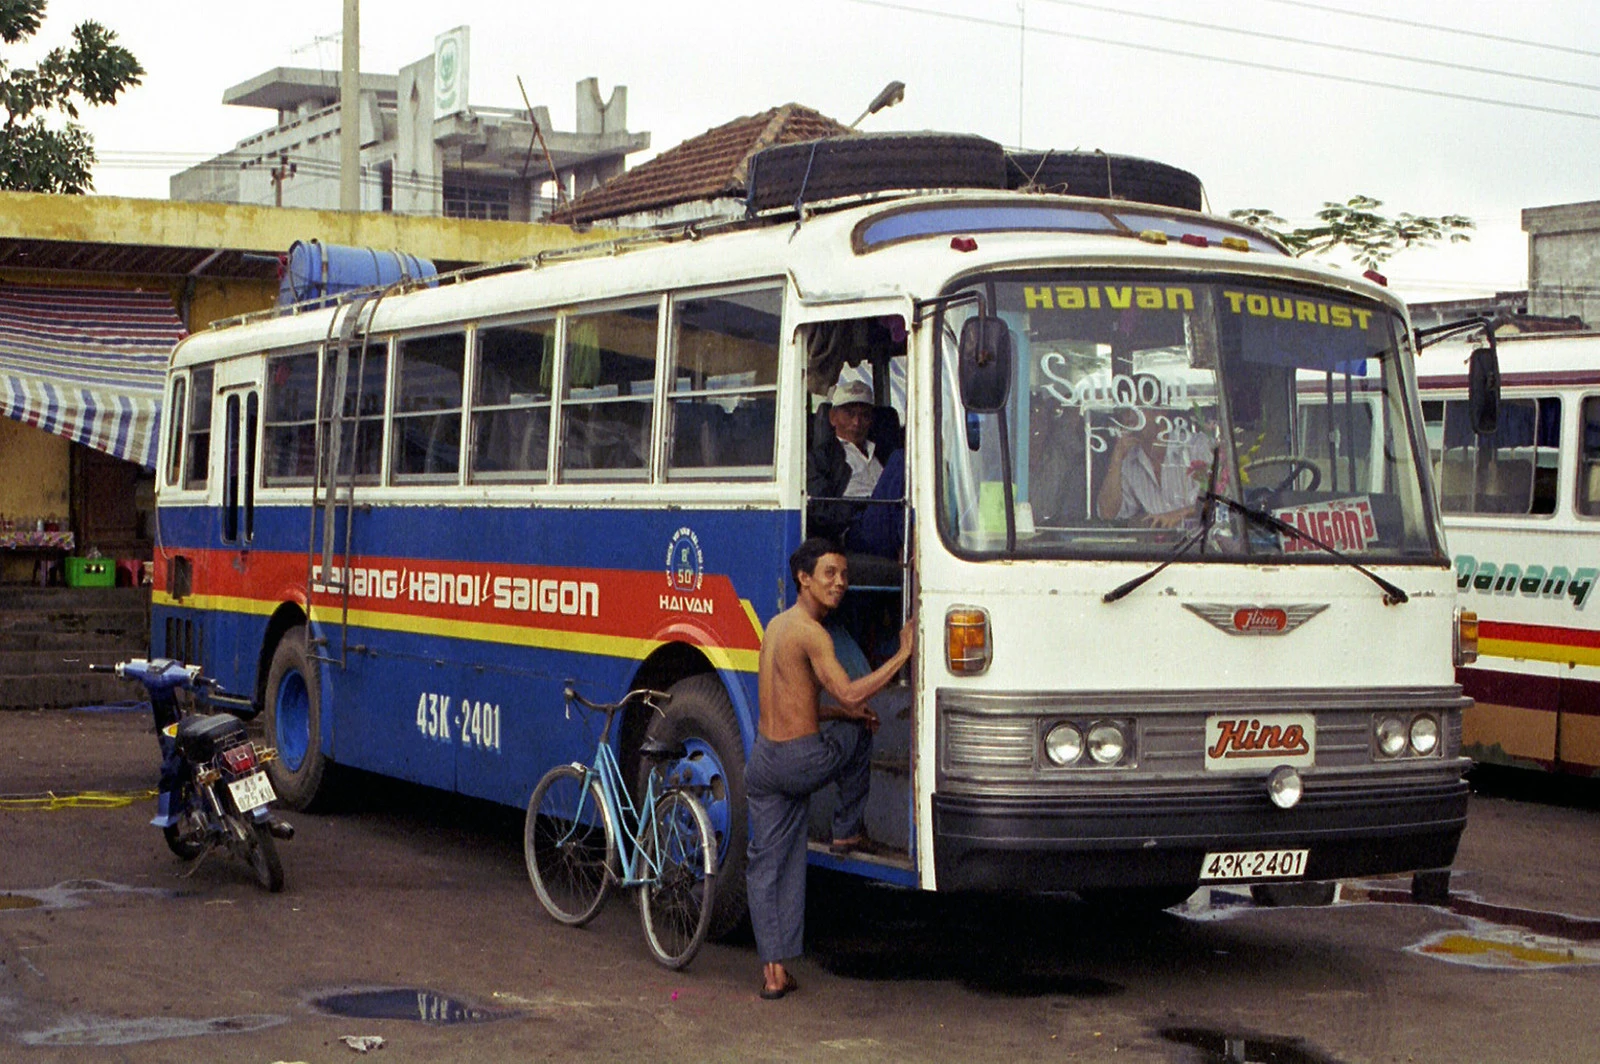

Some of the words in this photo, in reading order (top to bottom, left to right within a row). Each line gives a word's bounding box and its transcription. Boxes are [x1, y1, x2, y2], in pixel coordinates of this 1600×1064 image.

[1222, 290, 1373, 330] TOURIST
[1242, 609, 1280, 630] Hino
[1208, 719, 1310, 759] Hino
